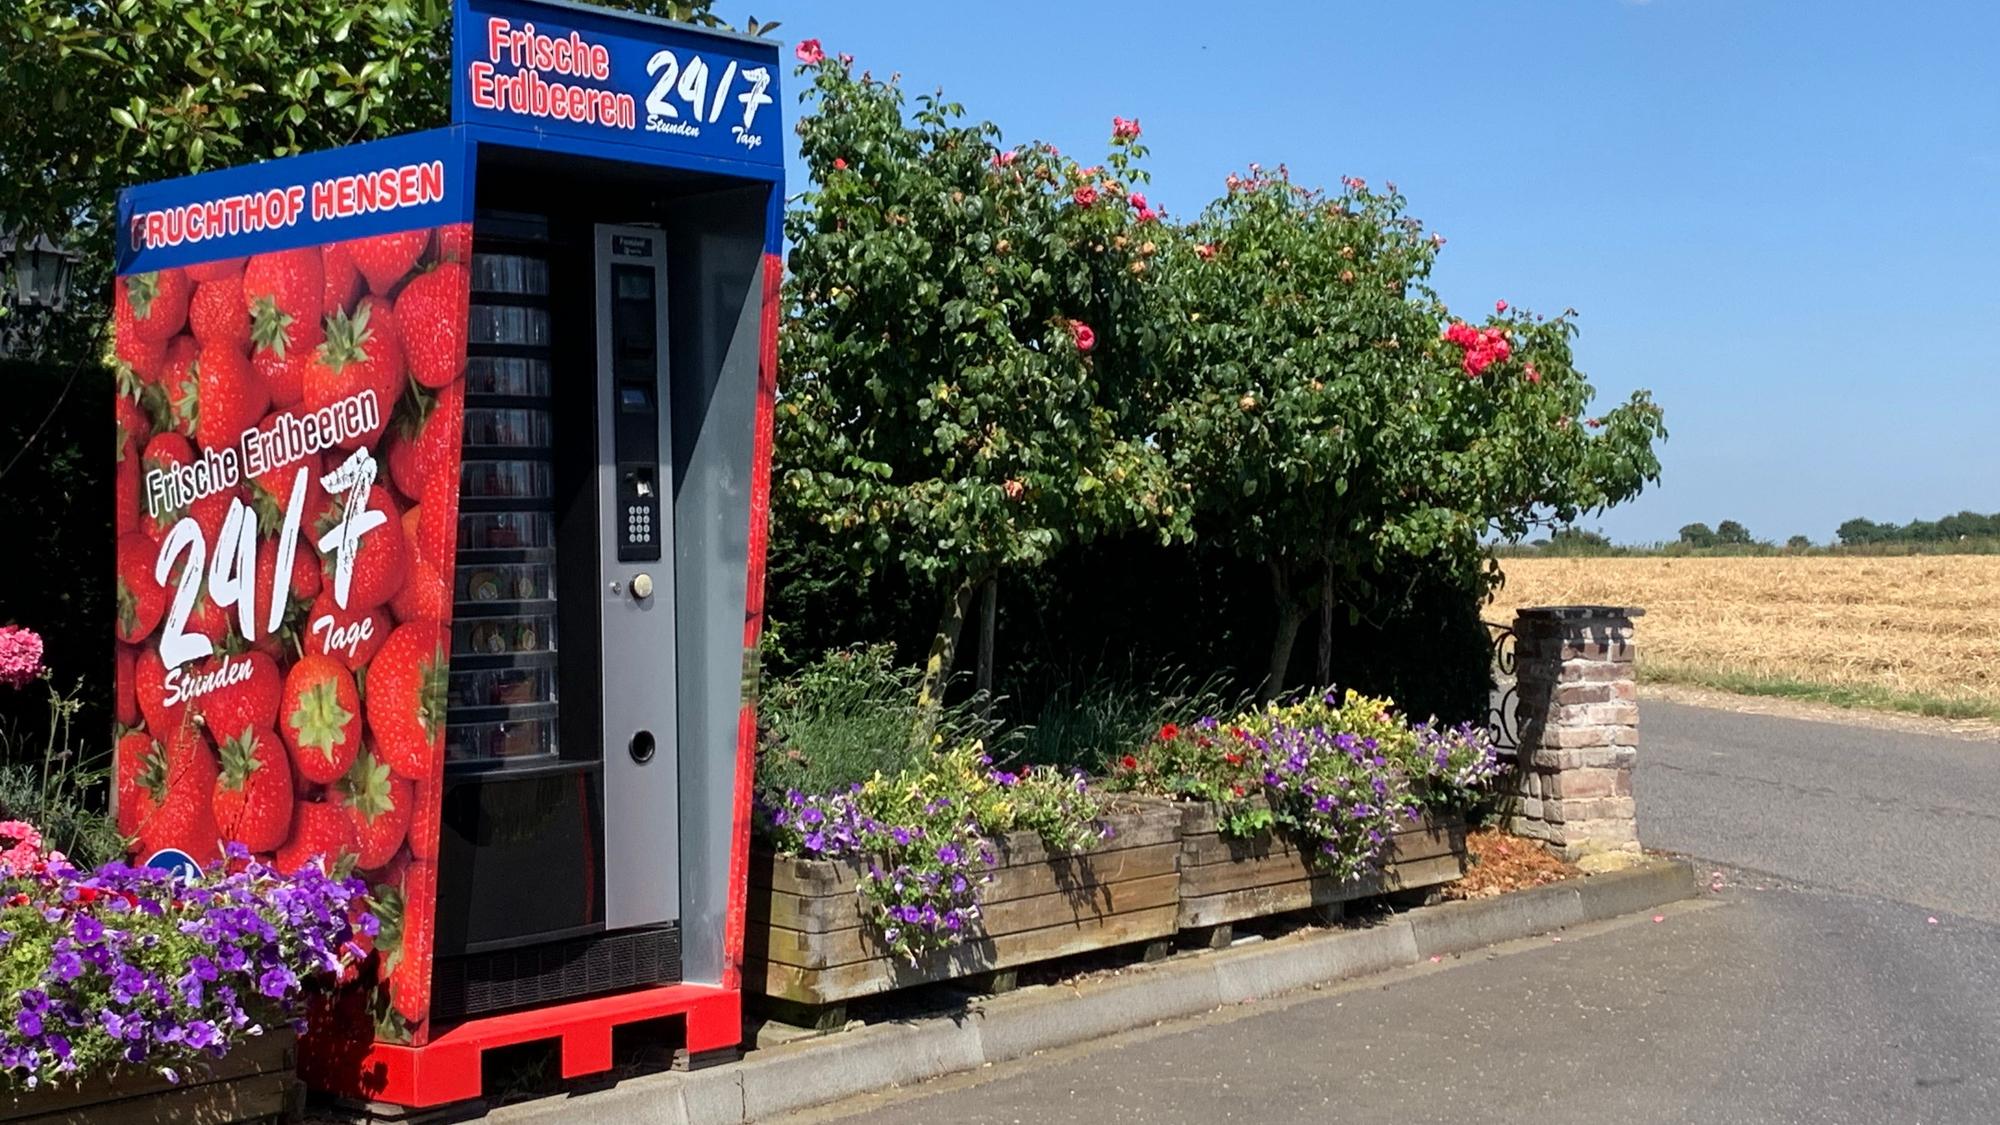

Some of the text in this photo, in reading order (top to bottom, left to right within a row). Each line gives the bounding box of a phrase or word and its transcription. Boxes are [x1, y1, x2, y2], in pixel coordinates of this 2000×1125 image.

[488, 17, 609, 81] Frische
[470, 61, 636, 130] Erdbeeren
[645, 50, 773, 128] 24/7
[645, 114, 700, 138] Stunden
[731, 125, 762, 150] Tage
[131, 160, 444, 252] FRUCHTHOF HENSEN
[146, 389, 380, 518] Frische Erdbeeren
[155, 446, 388, 670] 24/7
[312, 614, 374, 657] Tage
[163, 655, 254, 707] Stunden
